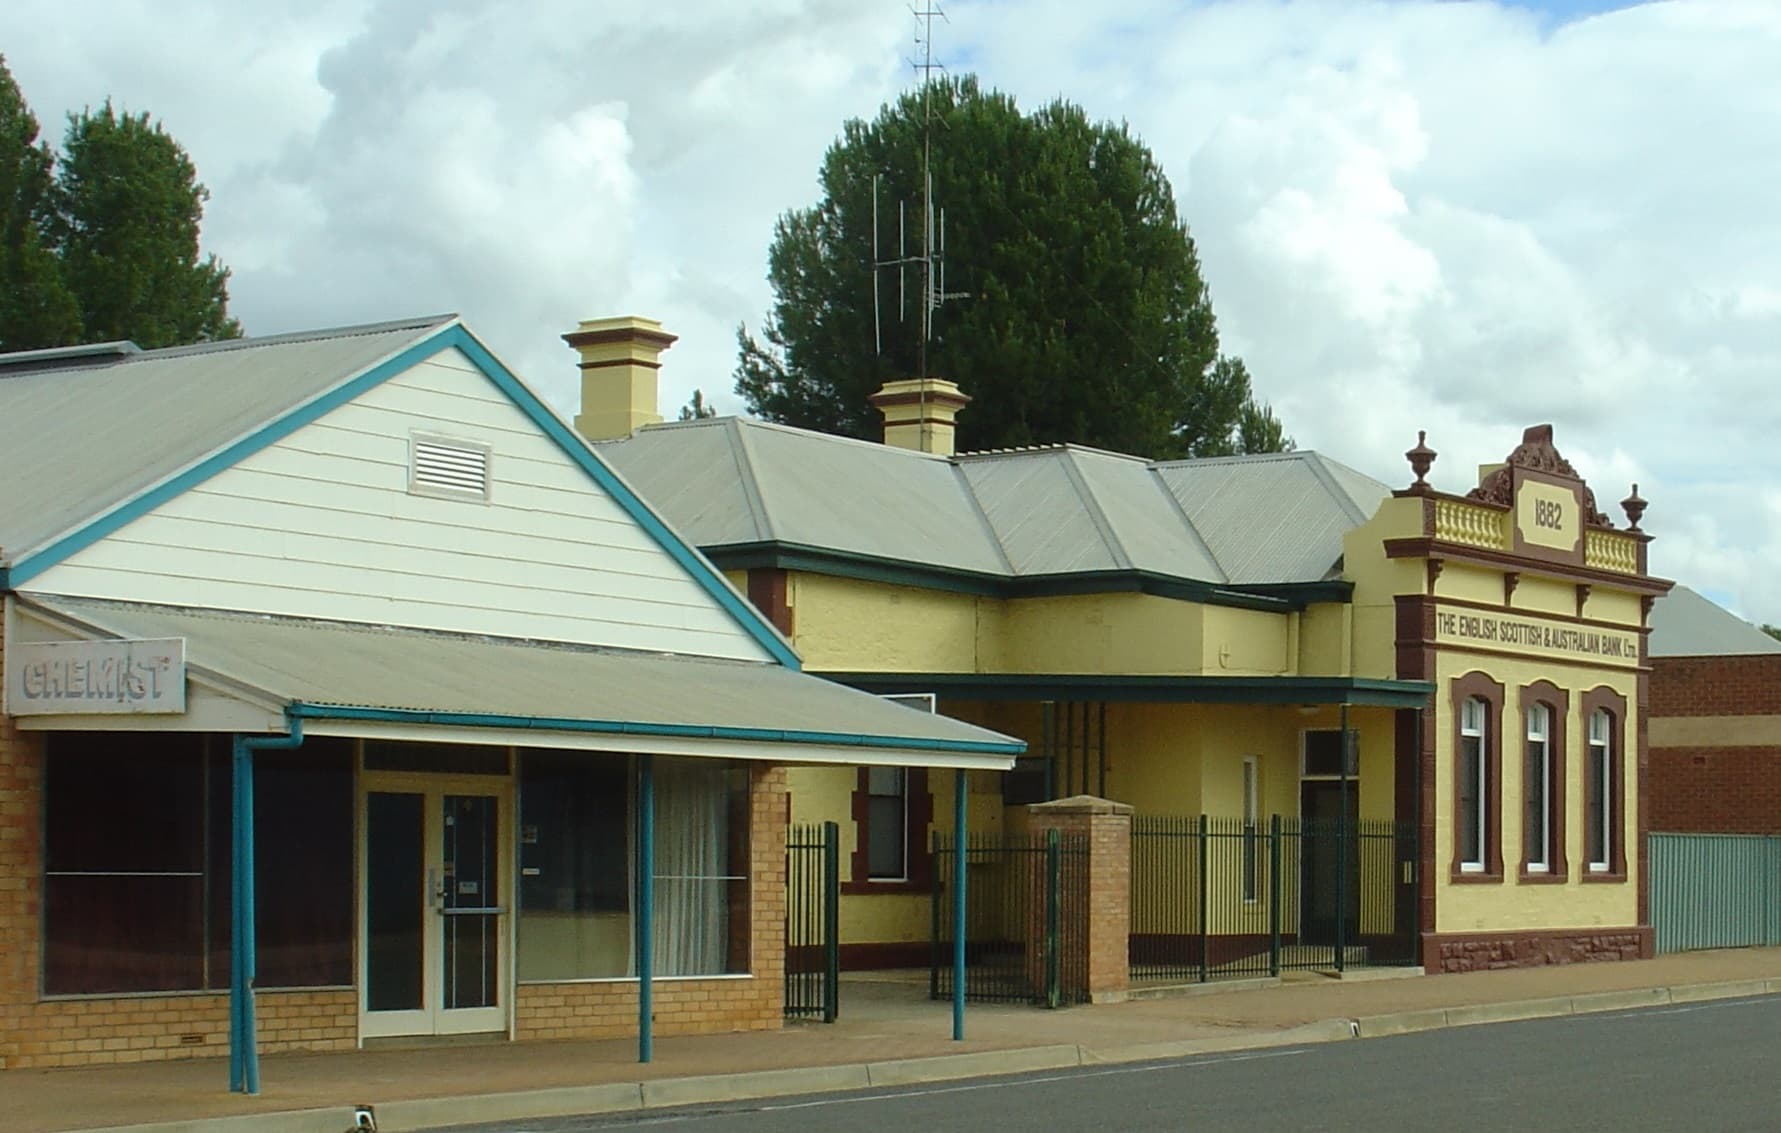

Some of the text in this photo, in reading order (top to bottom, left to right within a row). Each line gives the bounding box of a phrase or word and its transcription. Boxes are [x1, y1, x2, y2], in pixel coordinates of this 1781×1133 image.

[1536, 498, 1562, 530] 1882
[1437, 613, 1456, 635] THE
[1459, 616, 1497, 641] ENGLISH
[1500, 621, 1542, 646] SCOTTISH
[1544, 627, 1550, 647] &
[1552, 628, 1600, 653] AUSTRALIAN
[1602, 635, 1622, 657] BANK
[23, 657, 168, 700] CHEMIST
